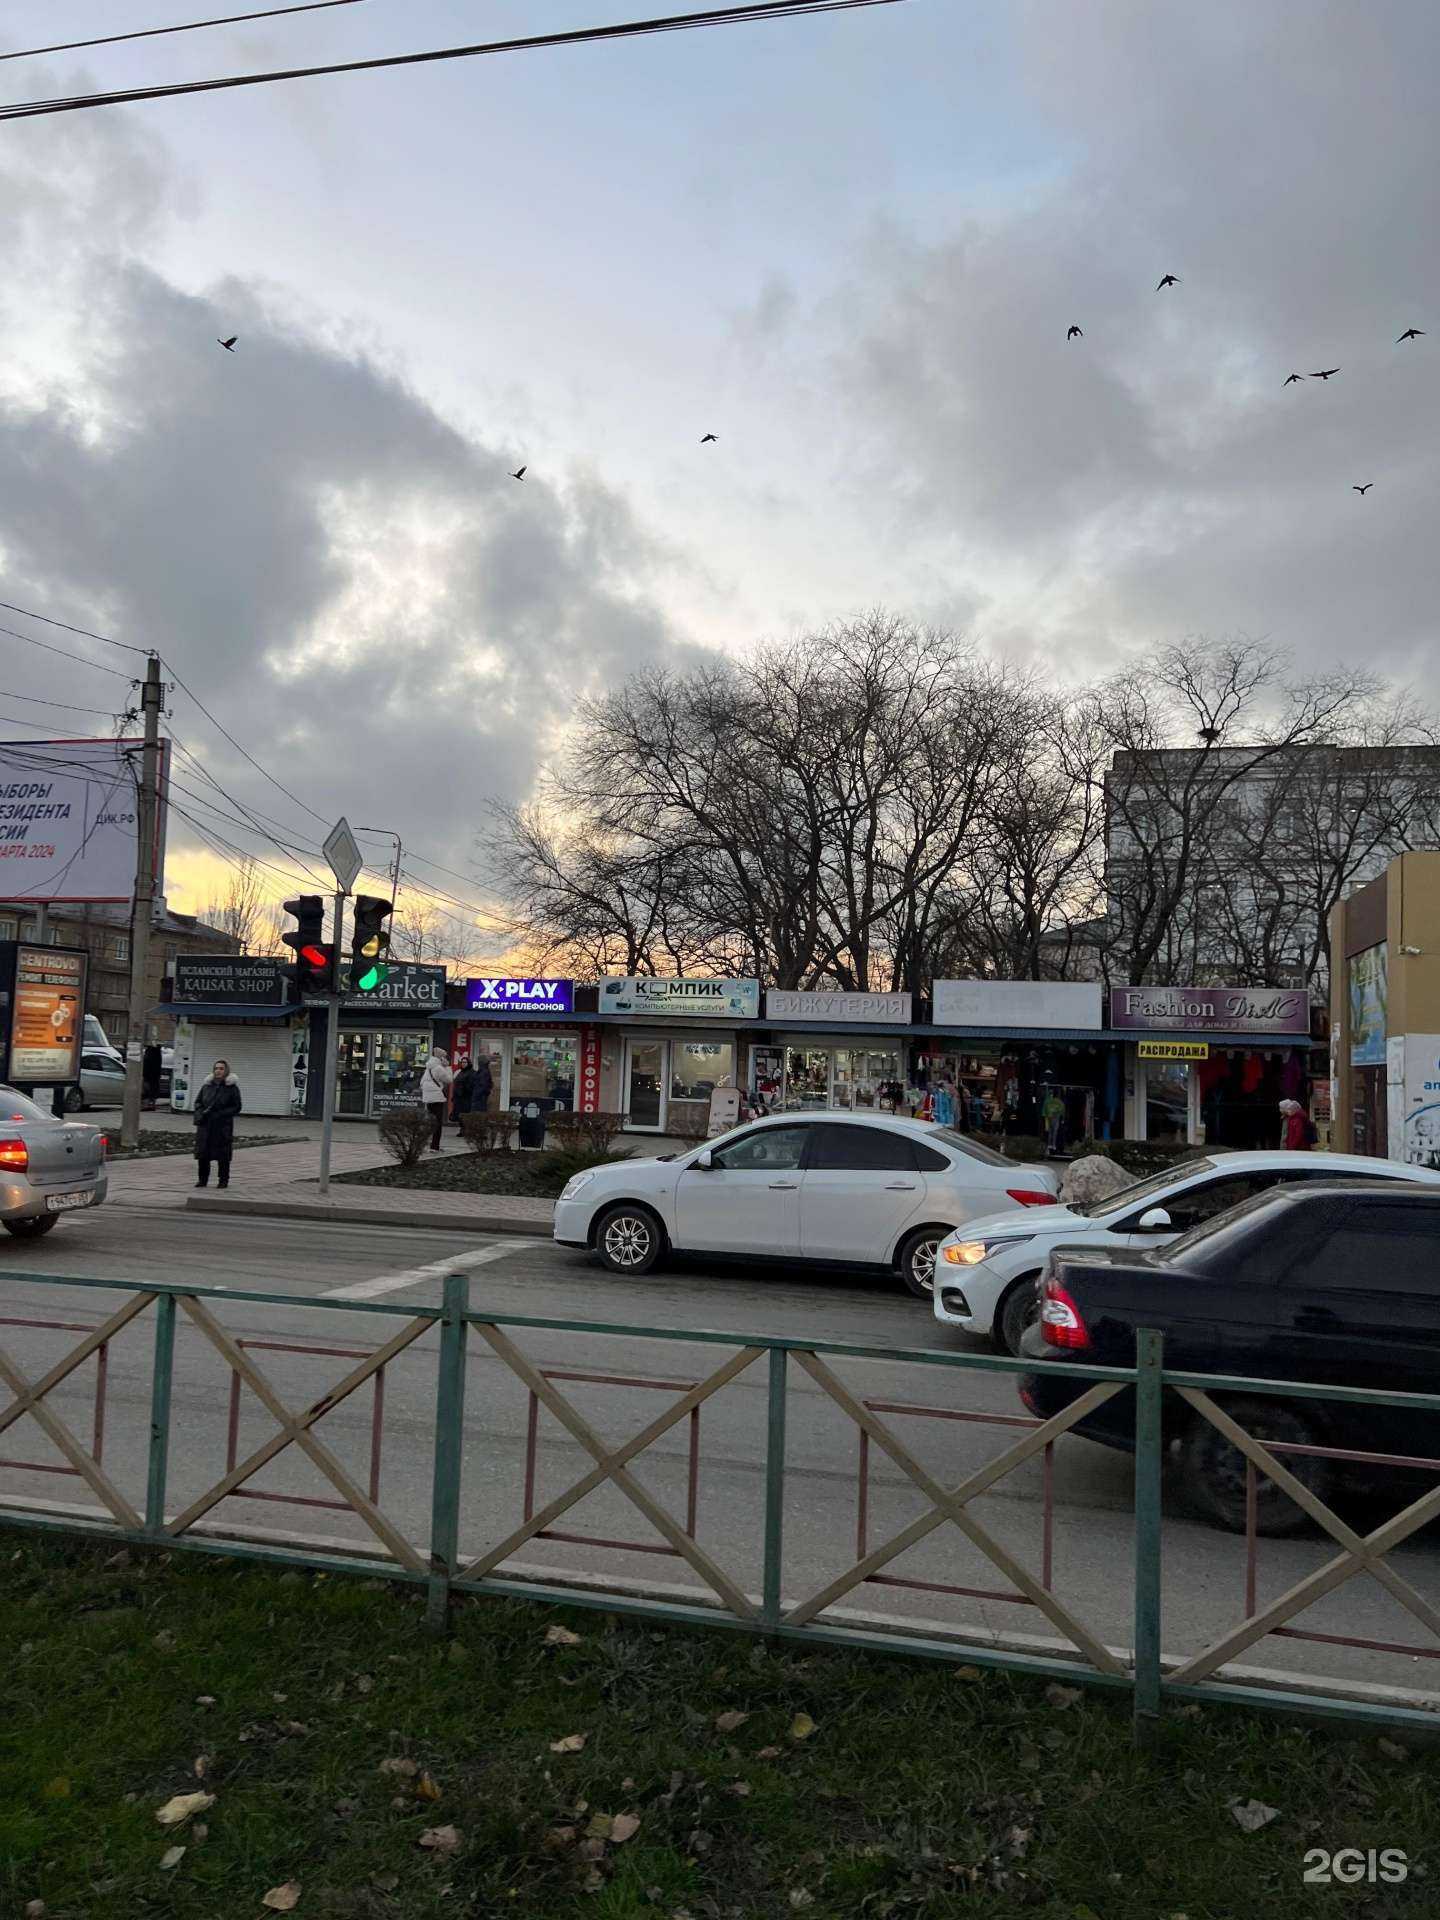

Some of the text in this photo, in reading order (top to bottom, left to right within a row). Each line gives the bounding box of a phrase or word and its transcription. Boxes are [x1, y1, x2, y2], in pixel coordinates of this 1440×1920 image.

[0, 844, 55, 859] АРТА 2024
[235, 967, 276, 977] МАГАЗИН
[184, 978, 274, 992] KAUSAR SHOP
[354, 975, 440, 999] arket
[472, 1001, 564, 1011] РЕМОНТ ТЕЛЕФОНОВ
[772, 996, 905, 1016] БИЖУТЕРИЯ
[1124, 993, 1215, 1017] Fashion
[1140, 1045, 1206, 1057] РАСПРОДАЖА
[586, 1021, 599, 1113] ТЕЛЕФОНО
